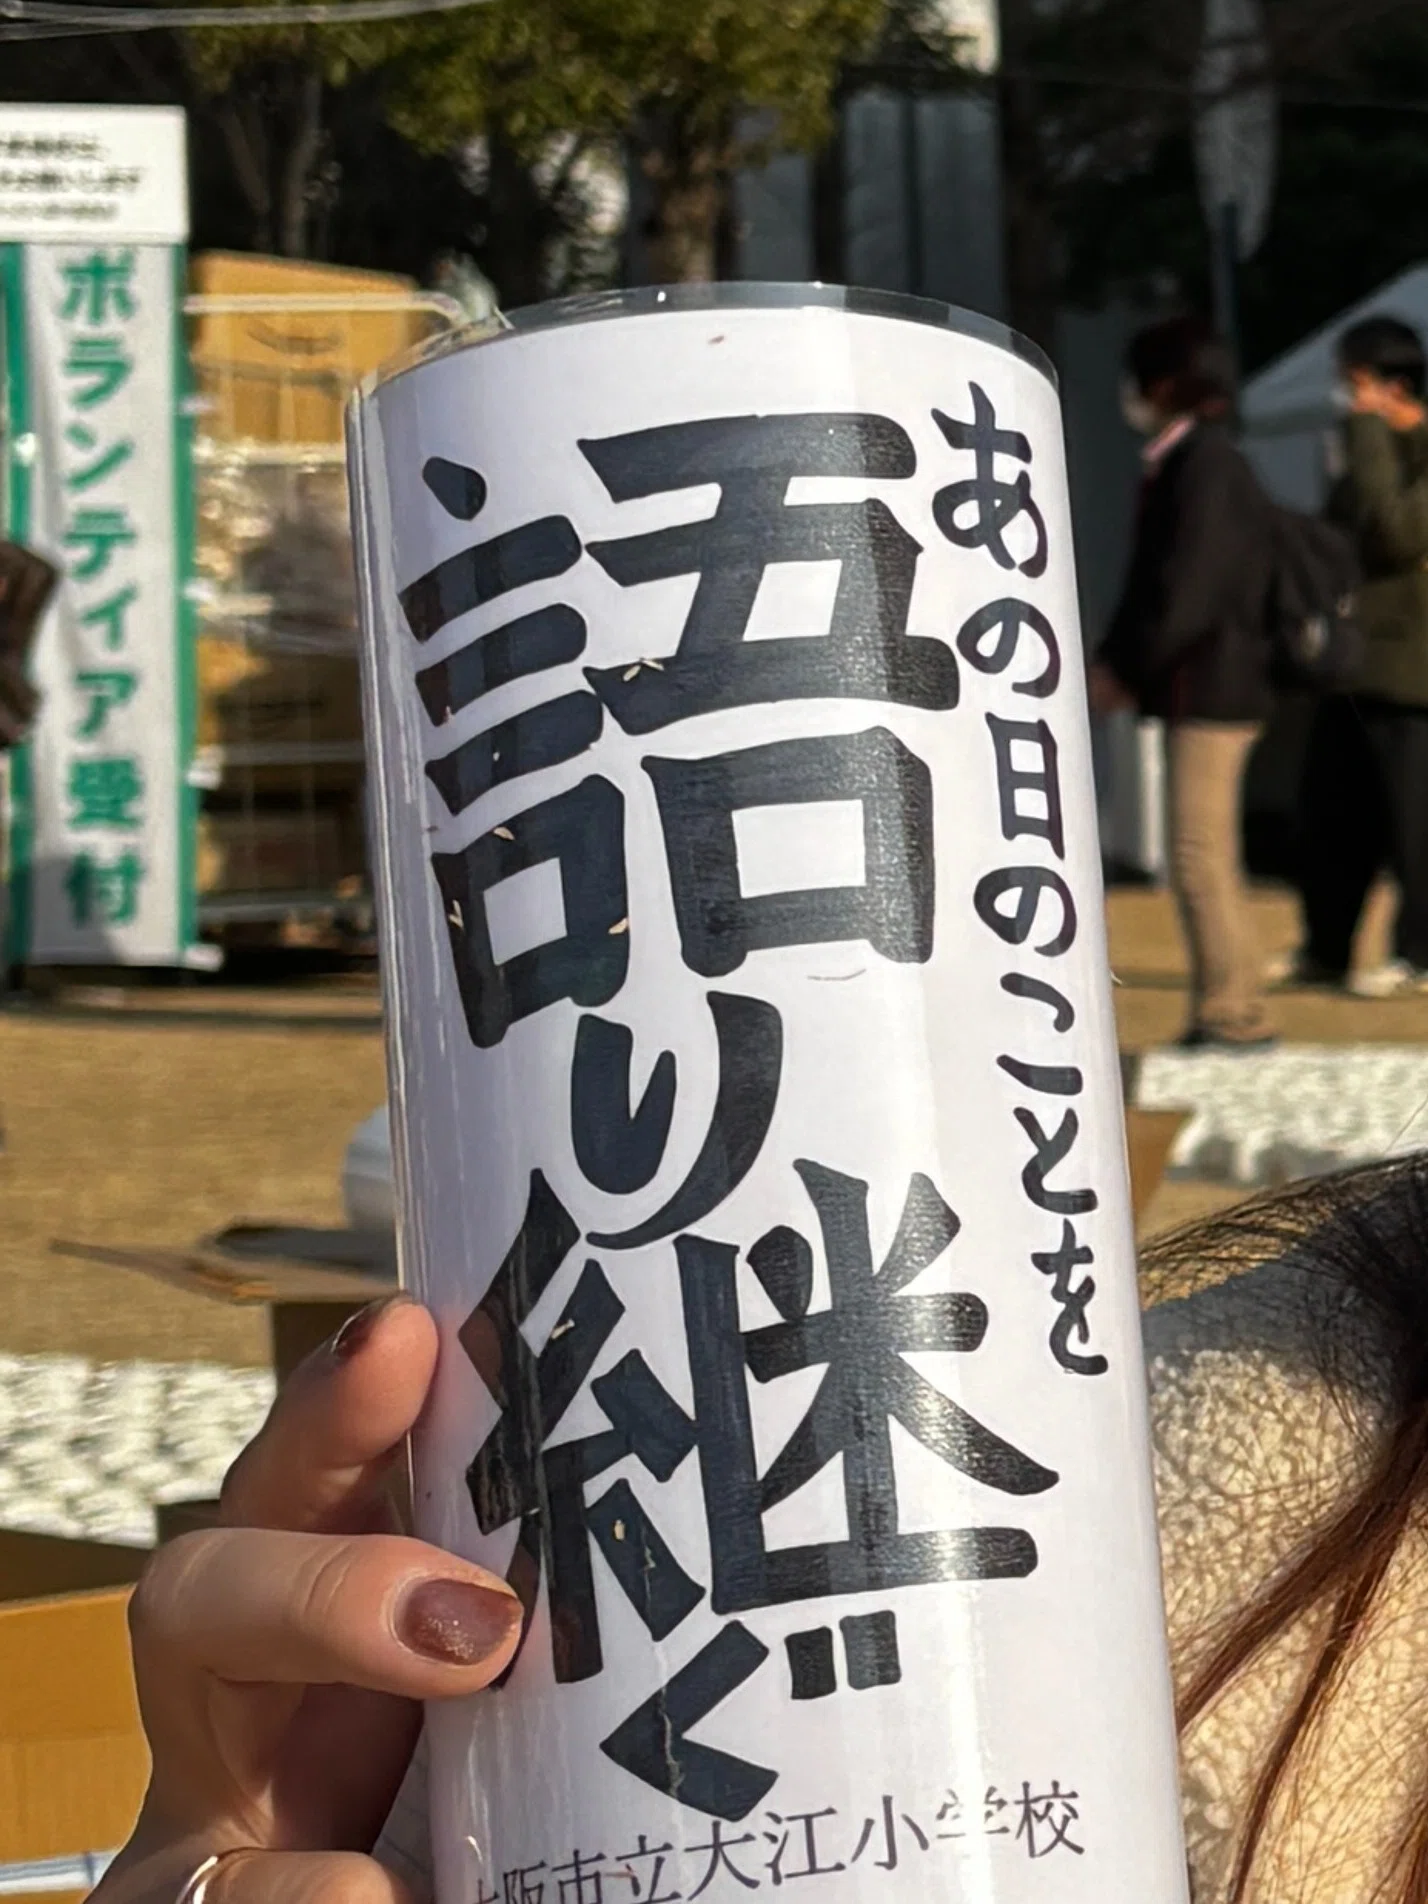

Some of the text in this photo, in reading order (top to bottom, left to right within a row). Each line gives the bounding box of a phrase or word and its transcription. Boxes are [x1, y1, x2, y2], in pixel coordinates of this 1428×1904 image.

[58, 249, 146, 928] ボランティア受付
[930, 380, 1108, 1375] あの日のことを
[399, 412, 1060, 1823] 語り継ぐ
